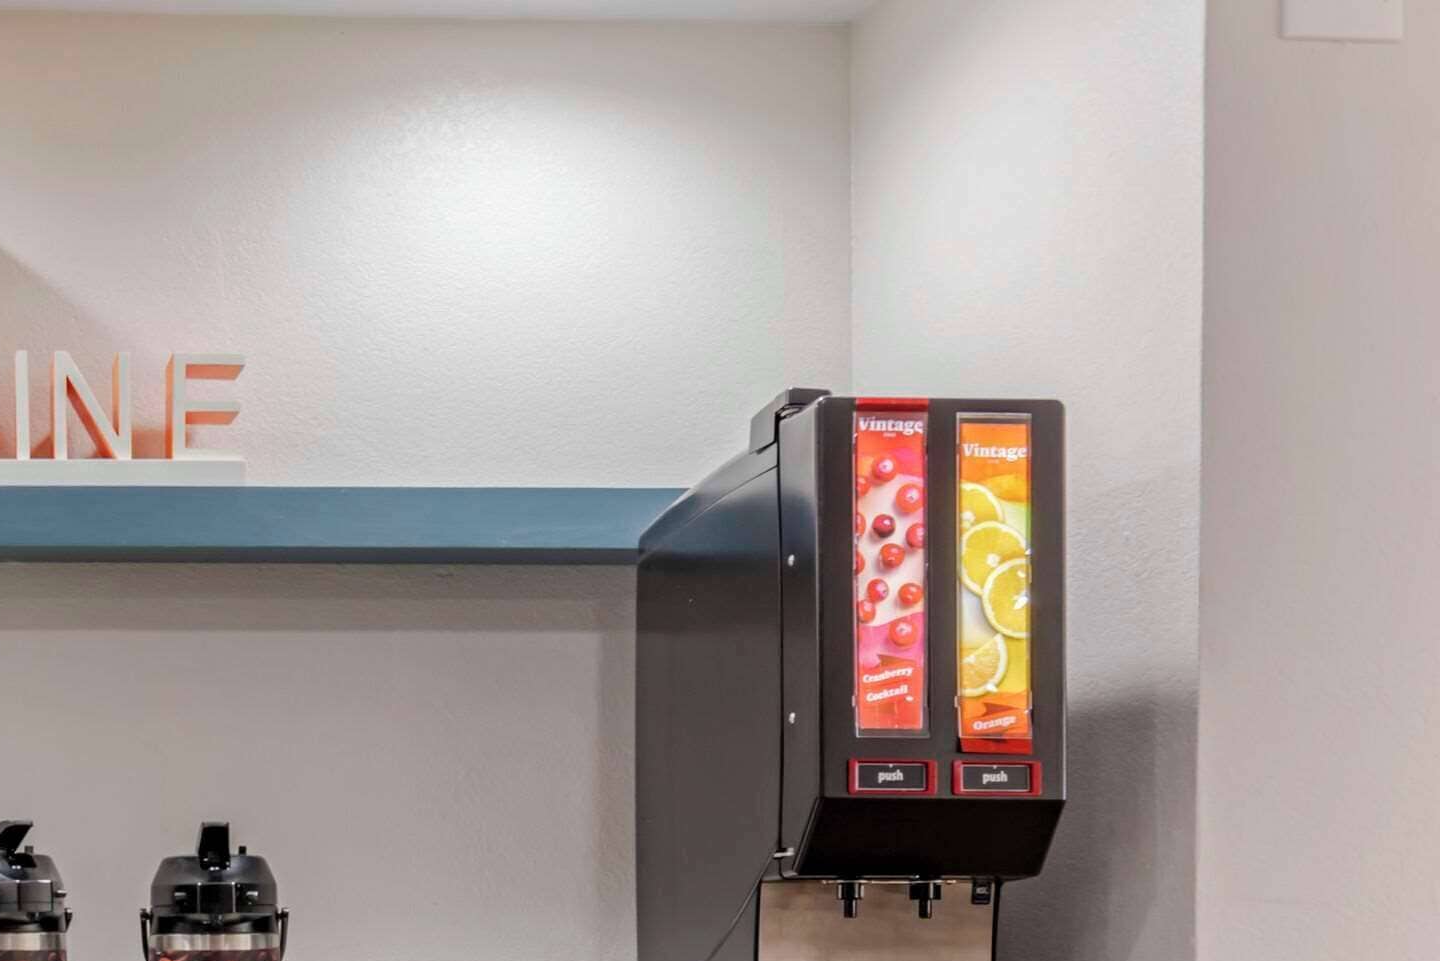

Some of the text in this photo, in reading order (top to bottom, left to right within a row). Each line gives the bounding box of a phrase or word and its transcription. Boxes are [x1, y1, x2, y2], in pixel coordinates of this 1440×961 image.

[859, 416, 924, 436] Vintage
[962, 443, 1028, 462] Vintage
[866, 685, 908, 702] Cocktail
[972, 716, 1016, 730] Orange
[878, 769, 904, 783] push
[982, 771, 1008, 784] push
